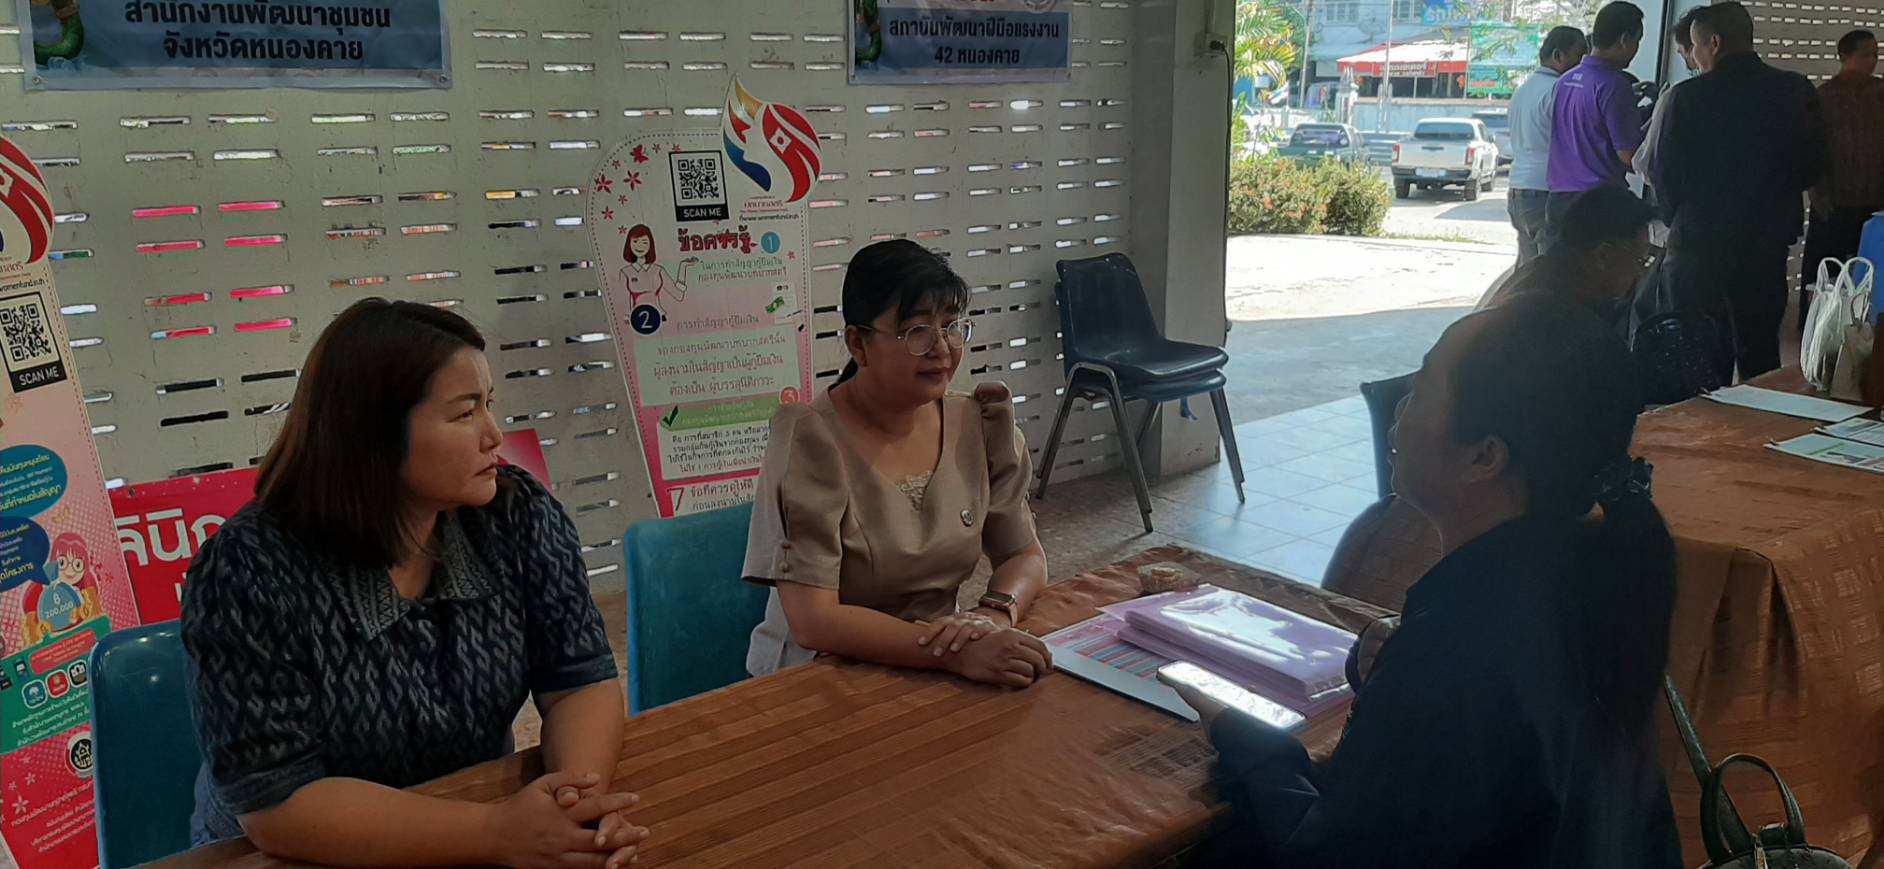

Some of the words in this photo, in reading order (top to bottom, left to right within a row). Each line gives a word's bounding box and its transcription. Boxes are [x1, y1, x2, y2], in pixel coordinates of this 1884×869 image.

[125, 0, 390, 34] สำนักงานพัฒนาชุมชน
[889, 15, 1059, 37] สถาบันพัฒนาฝีมือแรงงาน
[163, 31, 363, 60] จังหวัดหนองคาย
[935, 47, 953, 64] 42
[957, 47, 1020, 64] หนองคาย
[683, 208, 707, 218] SCAN
[709, 207, 722, 217] ME
[638, 310, 654, 329] 2
[19, 371, 45, 386] SCAN
[46, 366, 60, 379] ME
[669, 380, 706, 398] ต้องเป็น
[785, 389, 796, 403] 3
[666, 487, 685, 512] 7
